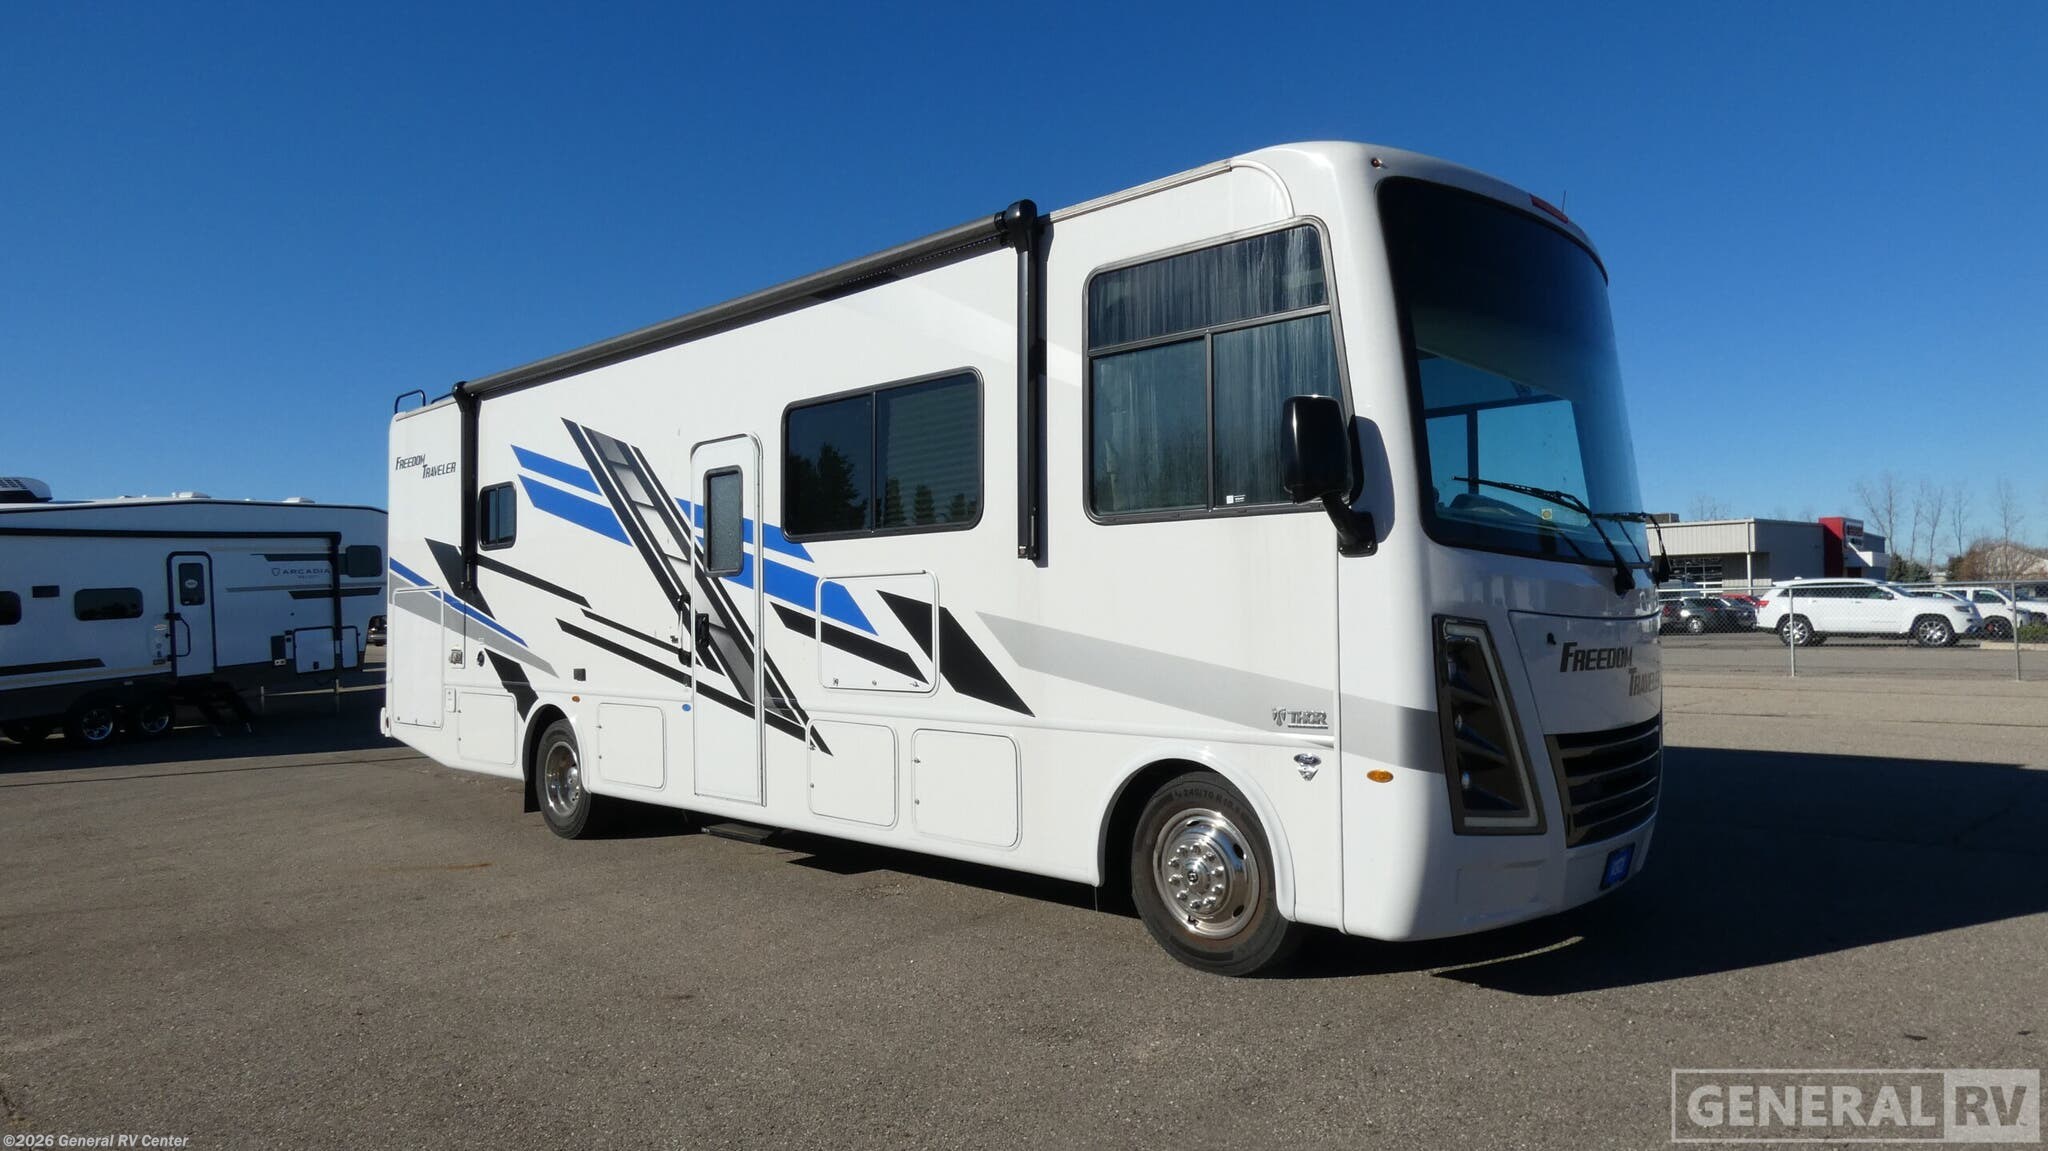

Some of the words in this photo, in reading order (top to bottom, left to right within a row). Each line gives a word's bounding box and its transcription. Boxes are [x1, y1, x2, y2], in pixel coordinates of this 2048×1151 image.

[396, 454, 426, 470] FREEDOM
[422, 461, 457, 479] TRAVELER
[1560, 641, 1633, 673] FREEDOM
[1287, 711, 1328, 725] THOR
